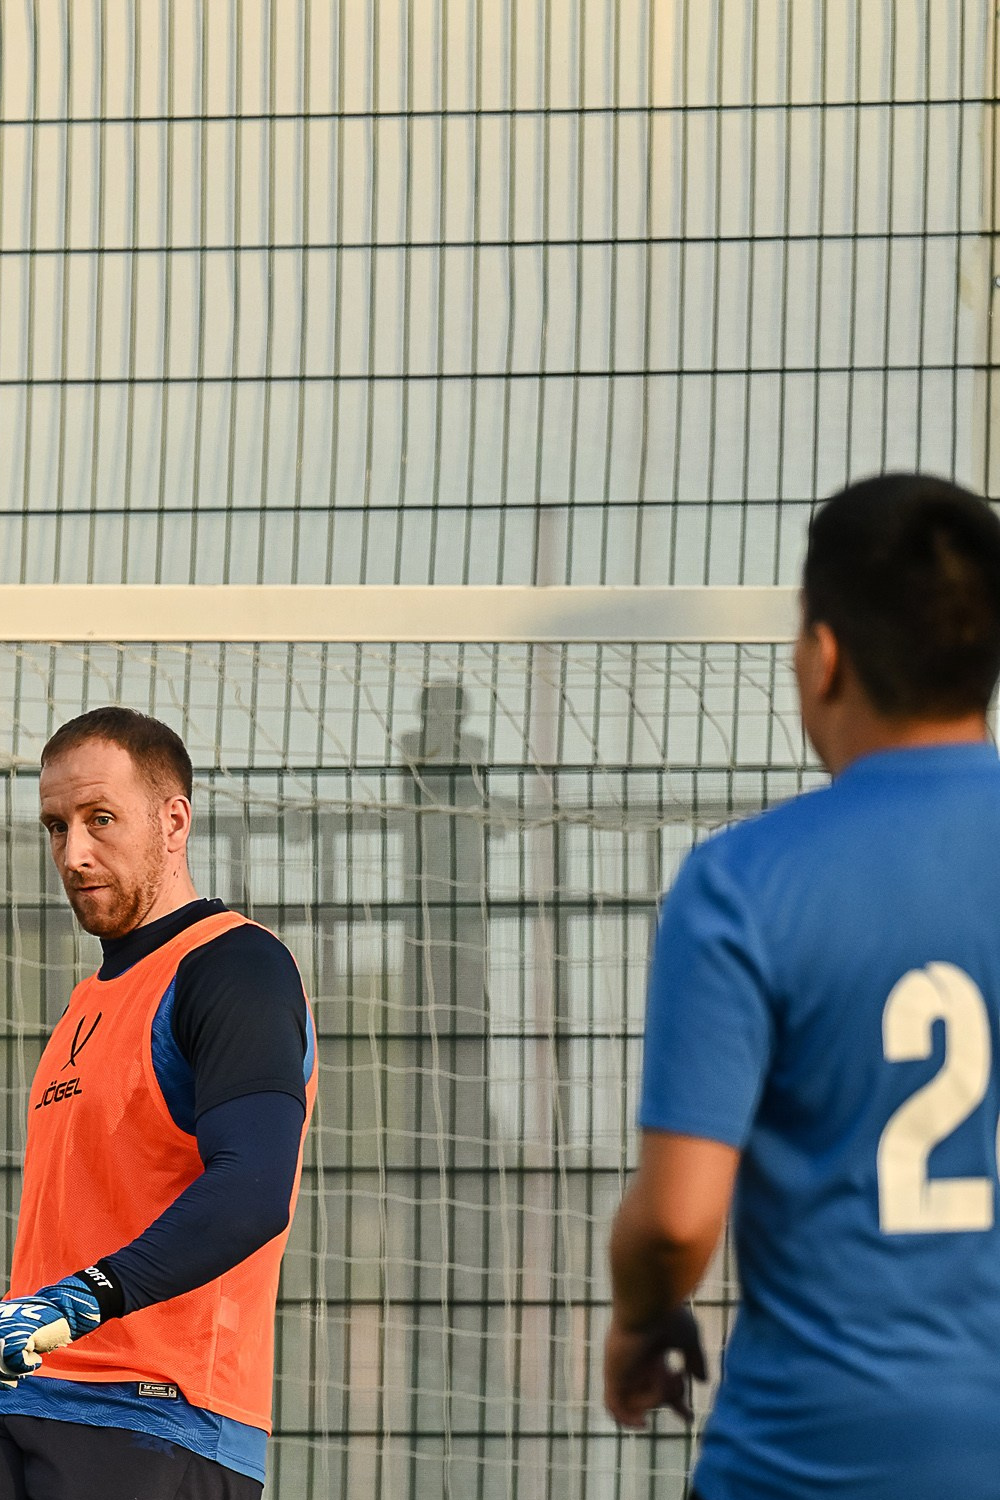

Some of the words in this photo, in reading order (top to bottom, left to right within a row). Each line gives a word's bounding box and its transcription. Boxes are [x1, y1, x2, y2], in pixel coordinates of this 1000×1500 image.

[35, 1077, 83, 1110] JÖGEL
[876, 961, 1000, 1235] 2
[84, 1265, 114, 1289] ORT
